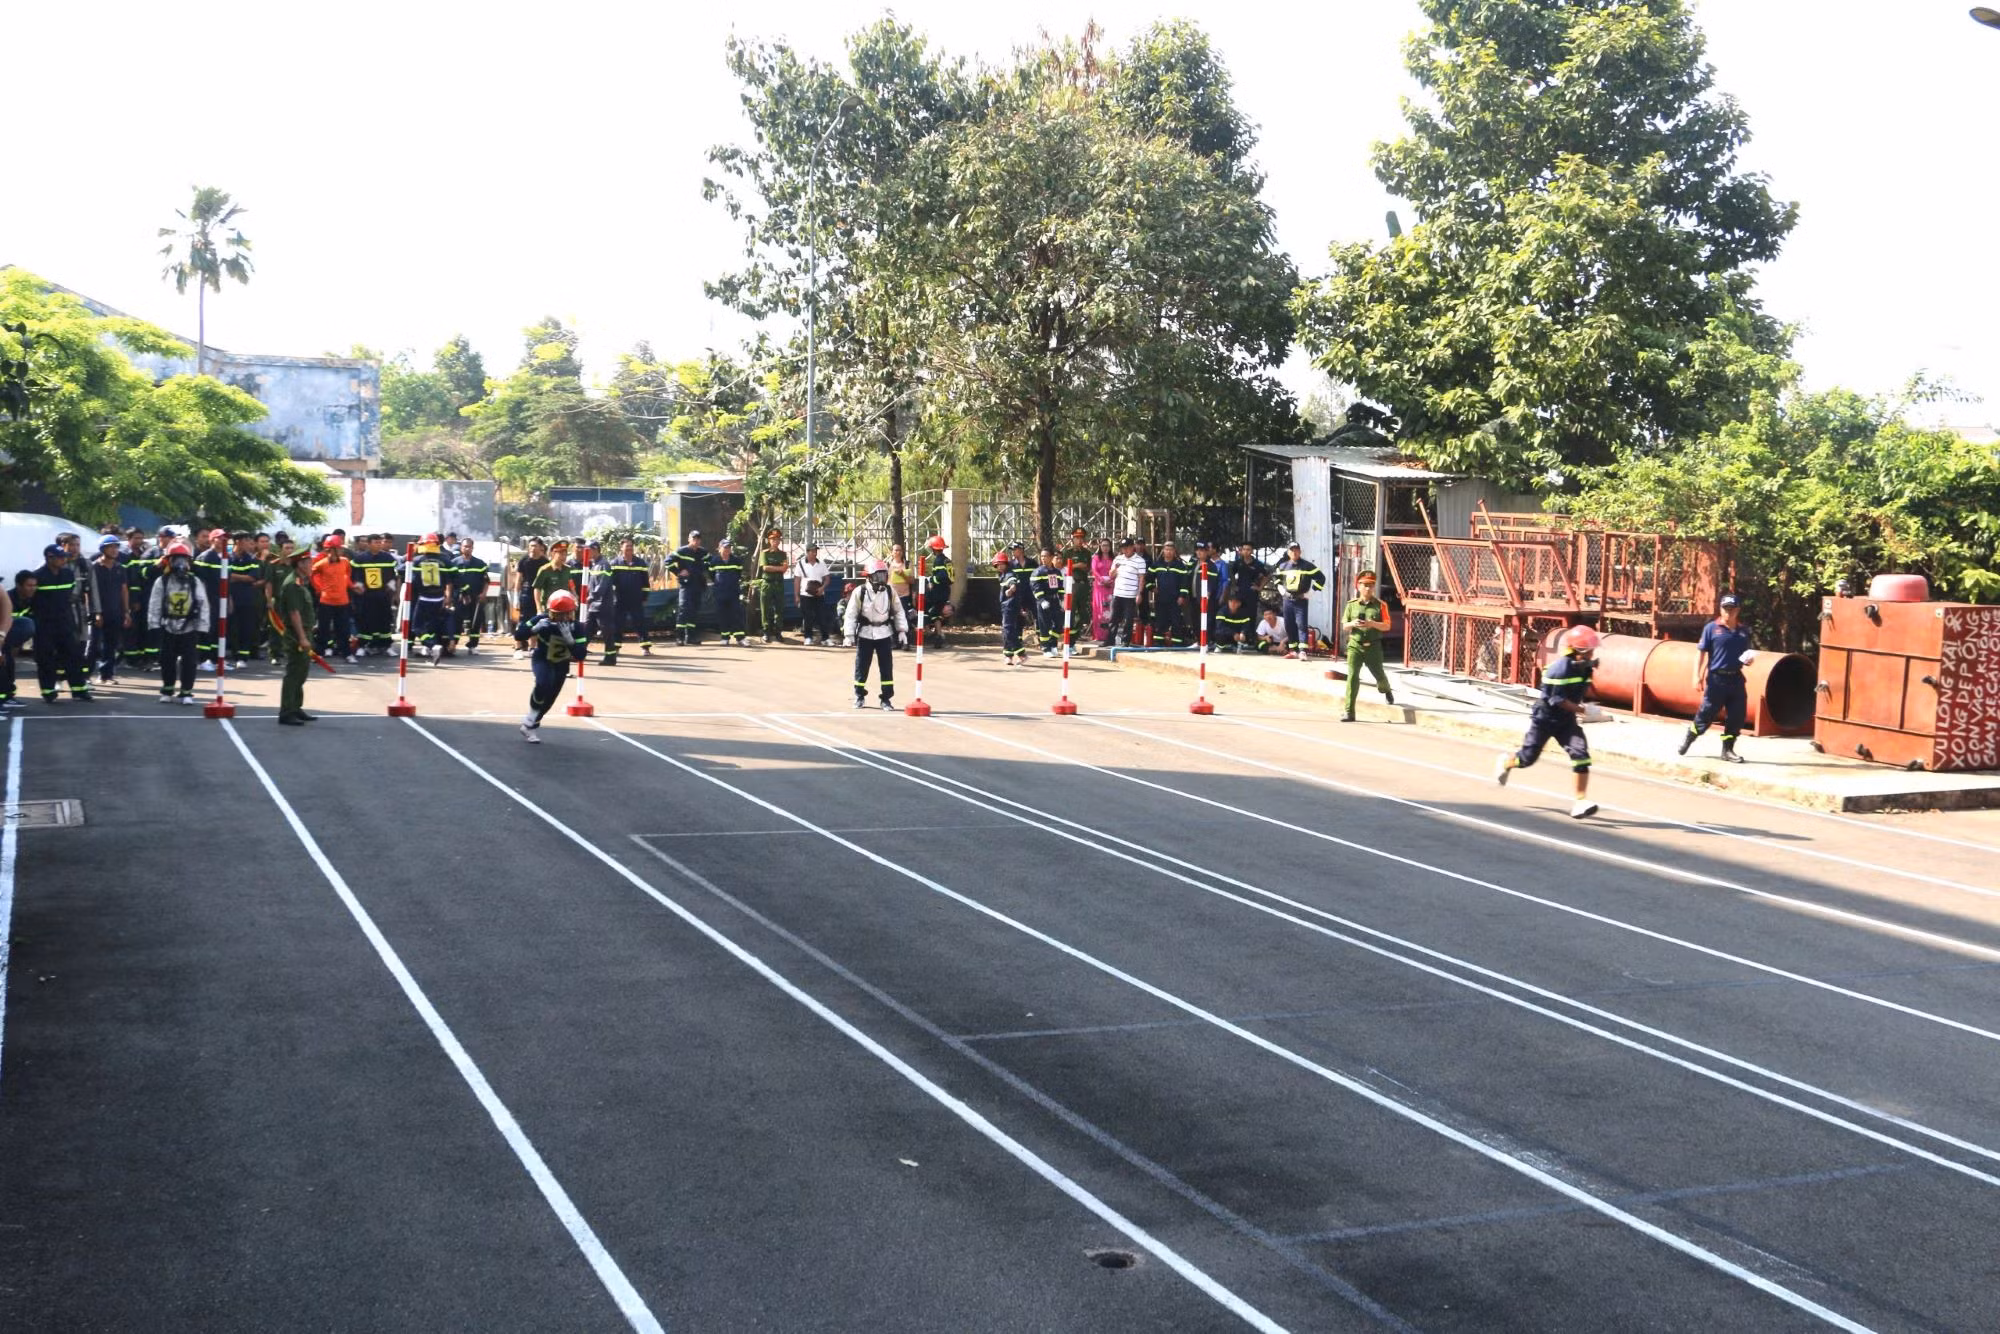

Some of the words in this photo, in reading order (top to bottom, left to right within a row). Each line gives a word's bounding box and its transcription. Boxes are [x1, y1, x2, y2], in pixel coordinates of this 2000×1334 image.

[370, 574, 378, 585] 2
[1933, 731, 1950, 770] VUI
[1950, 708, 1968, 768] XONG
